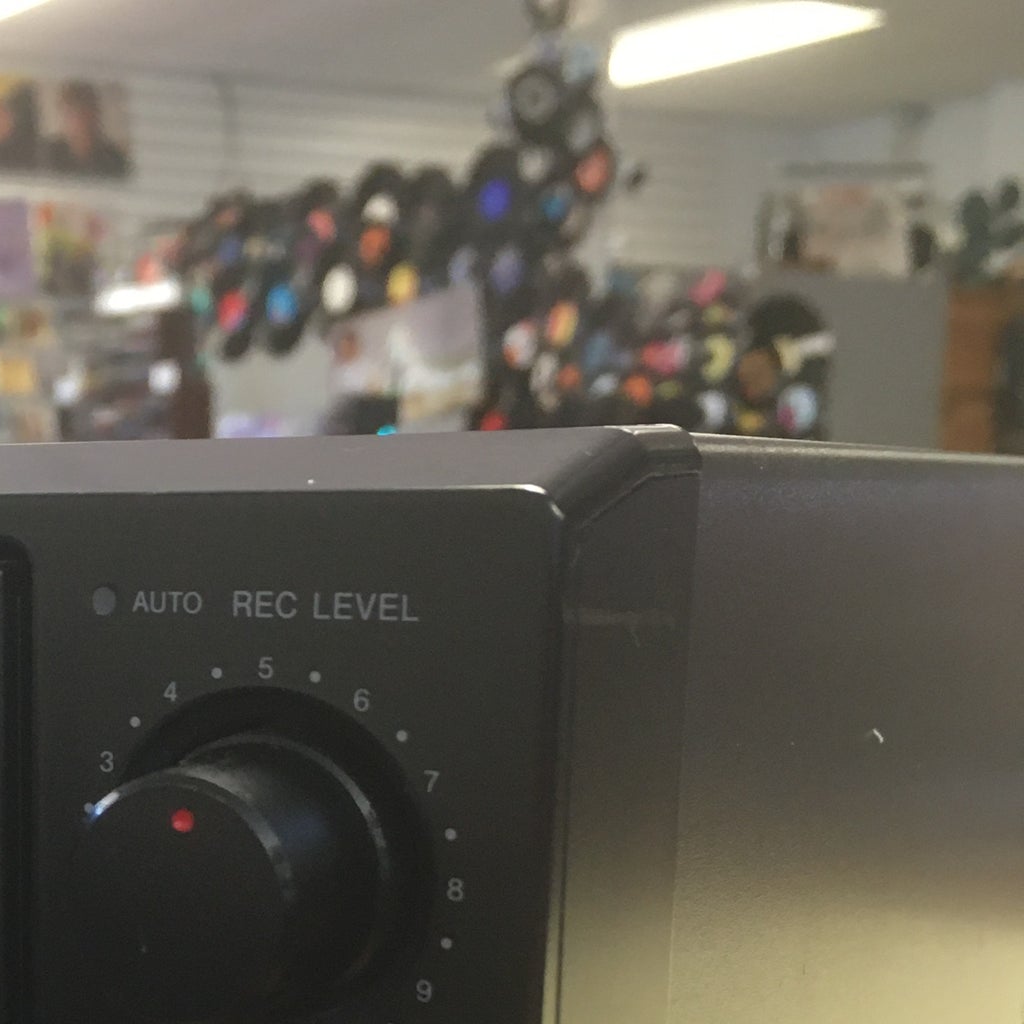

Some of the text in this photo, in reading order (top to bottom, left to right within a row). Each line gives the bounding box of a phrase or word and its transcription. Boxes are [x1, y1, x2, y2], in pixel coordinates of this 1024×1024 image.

[132, 591, 203, 614] AUTO
[232, 591, 419, 622] REC LEVEL
[257, 657, 274, 680] 5
[163, 681, 178, 702] 4
[353, 688, 371, 712] 6
[99, 751, 114, 772] 3
[424, 770, 440, 792] 7
[447, 878, 464, 902] 8
[416, 979, 433, 1003] 9
